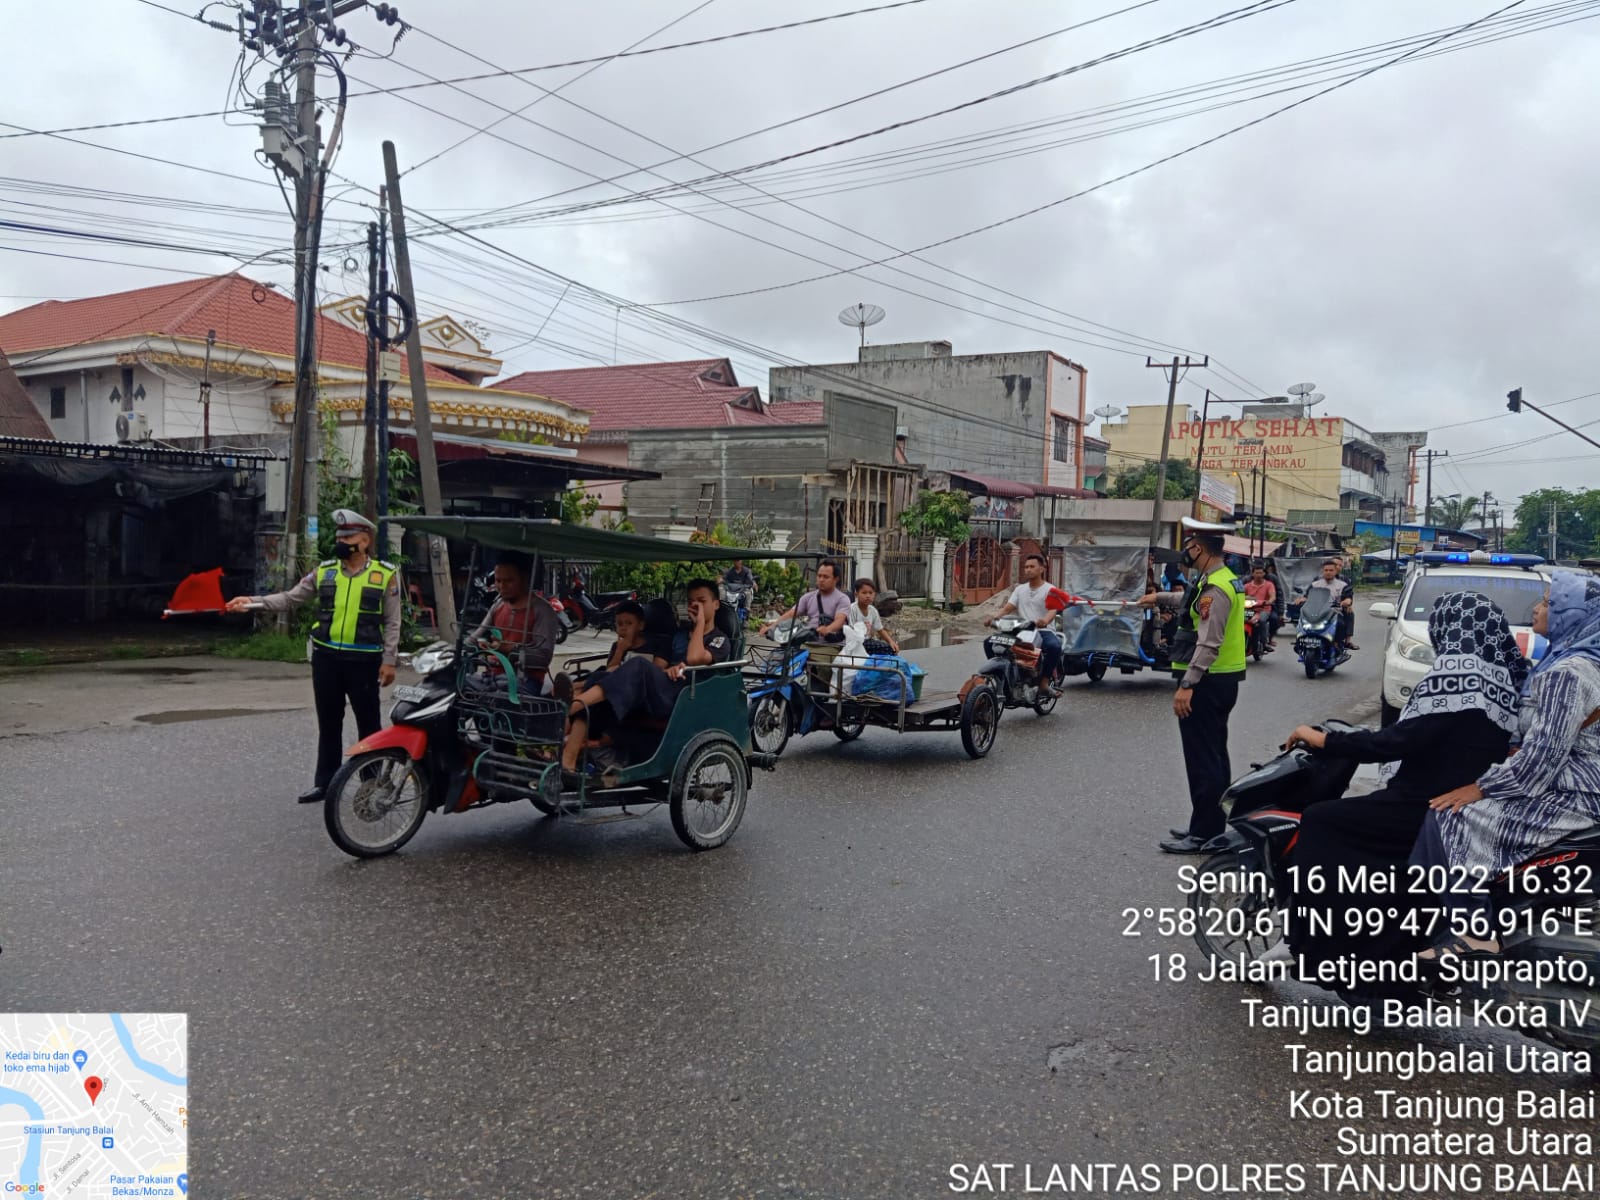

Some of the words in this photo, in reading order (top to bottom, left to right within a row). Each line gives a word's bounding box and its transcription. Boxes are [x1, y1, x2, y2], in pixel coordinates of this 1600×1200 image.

[1255, 417, 1340, 437] SEHAT
[1234, 444, 1293, 456] TERJAMIN
[1231, 458, 1306, 469] TERJANGKAU
